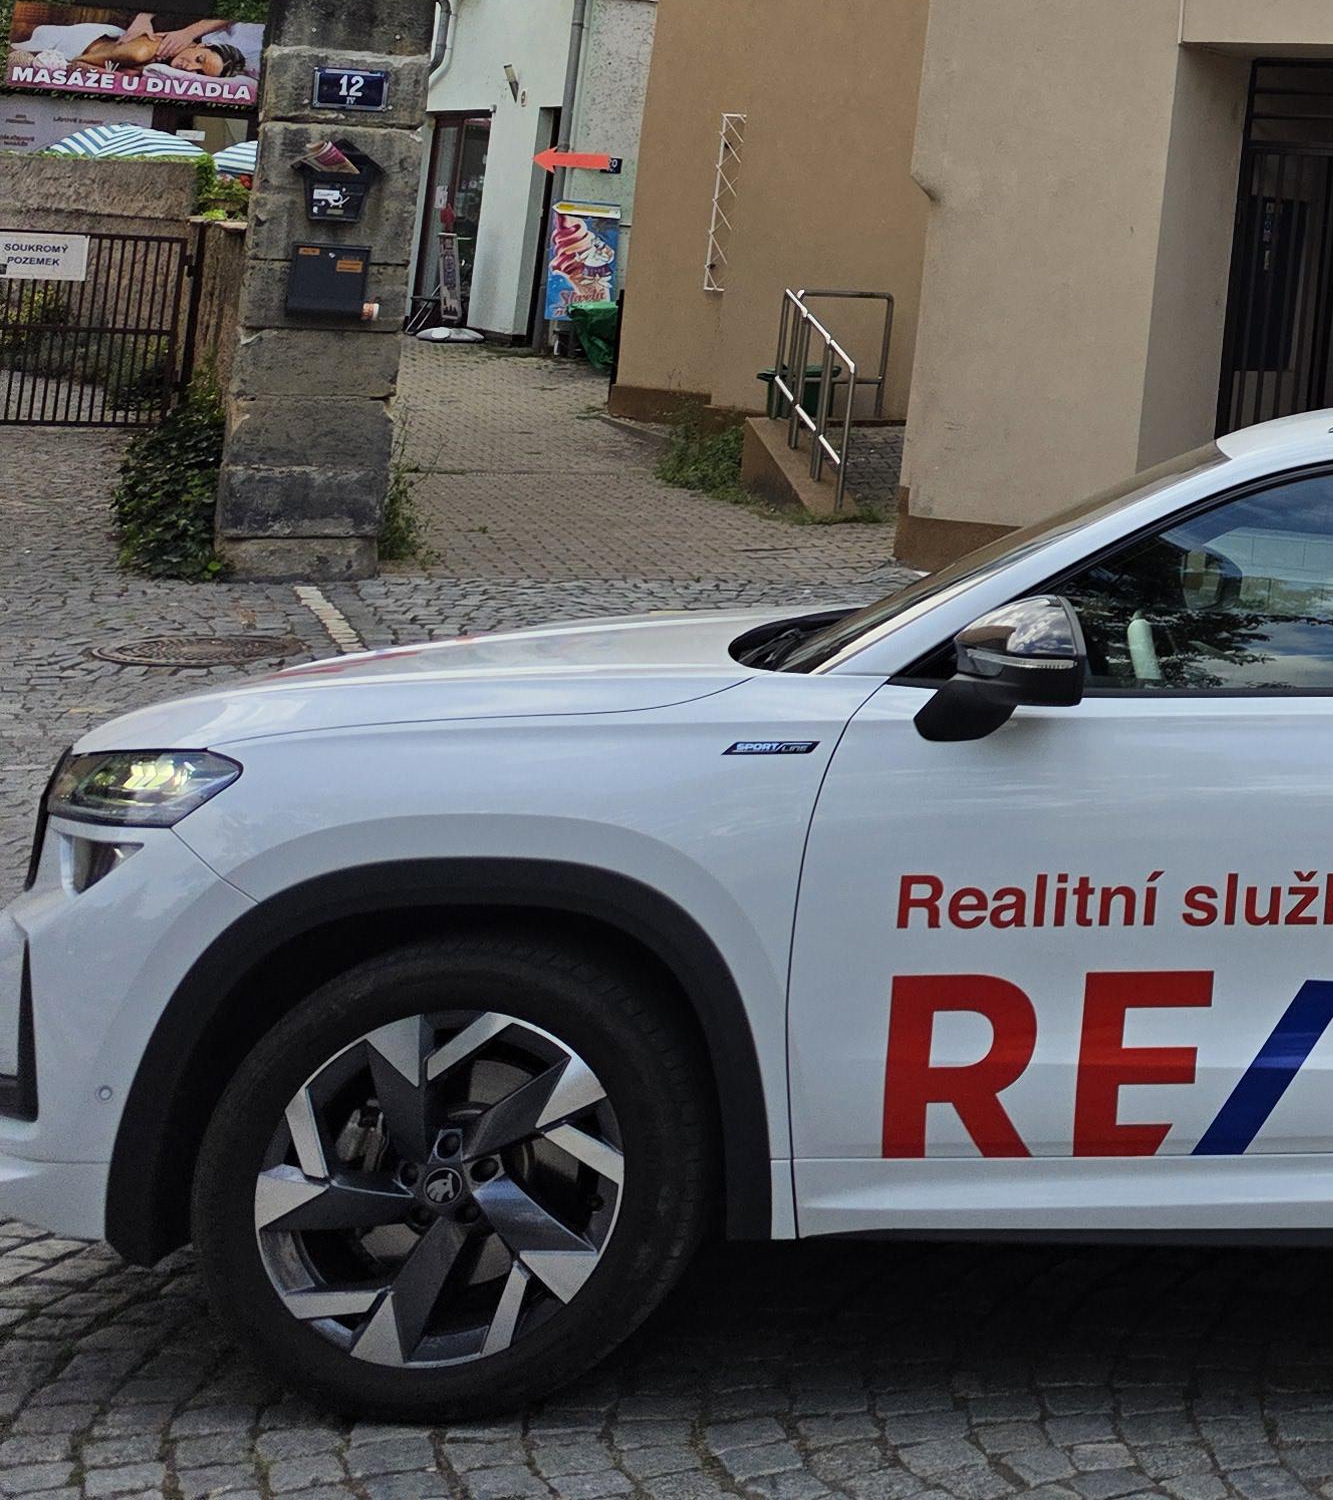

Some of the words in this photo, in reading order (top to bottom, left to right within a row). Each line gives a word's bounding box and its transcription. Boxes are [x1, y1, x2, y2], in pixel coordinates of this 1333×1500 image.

[12, 66, 114, 90] MASÁŽE
[122, 76, 139, 91] U
[146, 78, 251, 100] DIVADLA
[339, 74, 364, 96] 12
[4, 243, 69, 254] SOUKROMÝ
[7, 256, 60, 266] POZEMEK
[897, 870, 1166, 930] Realitní
